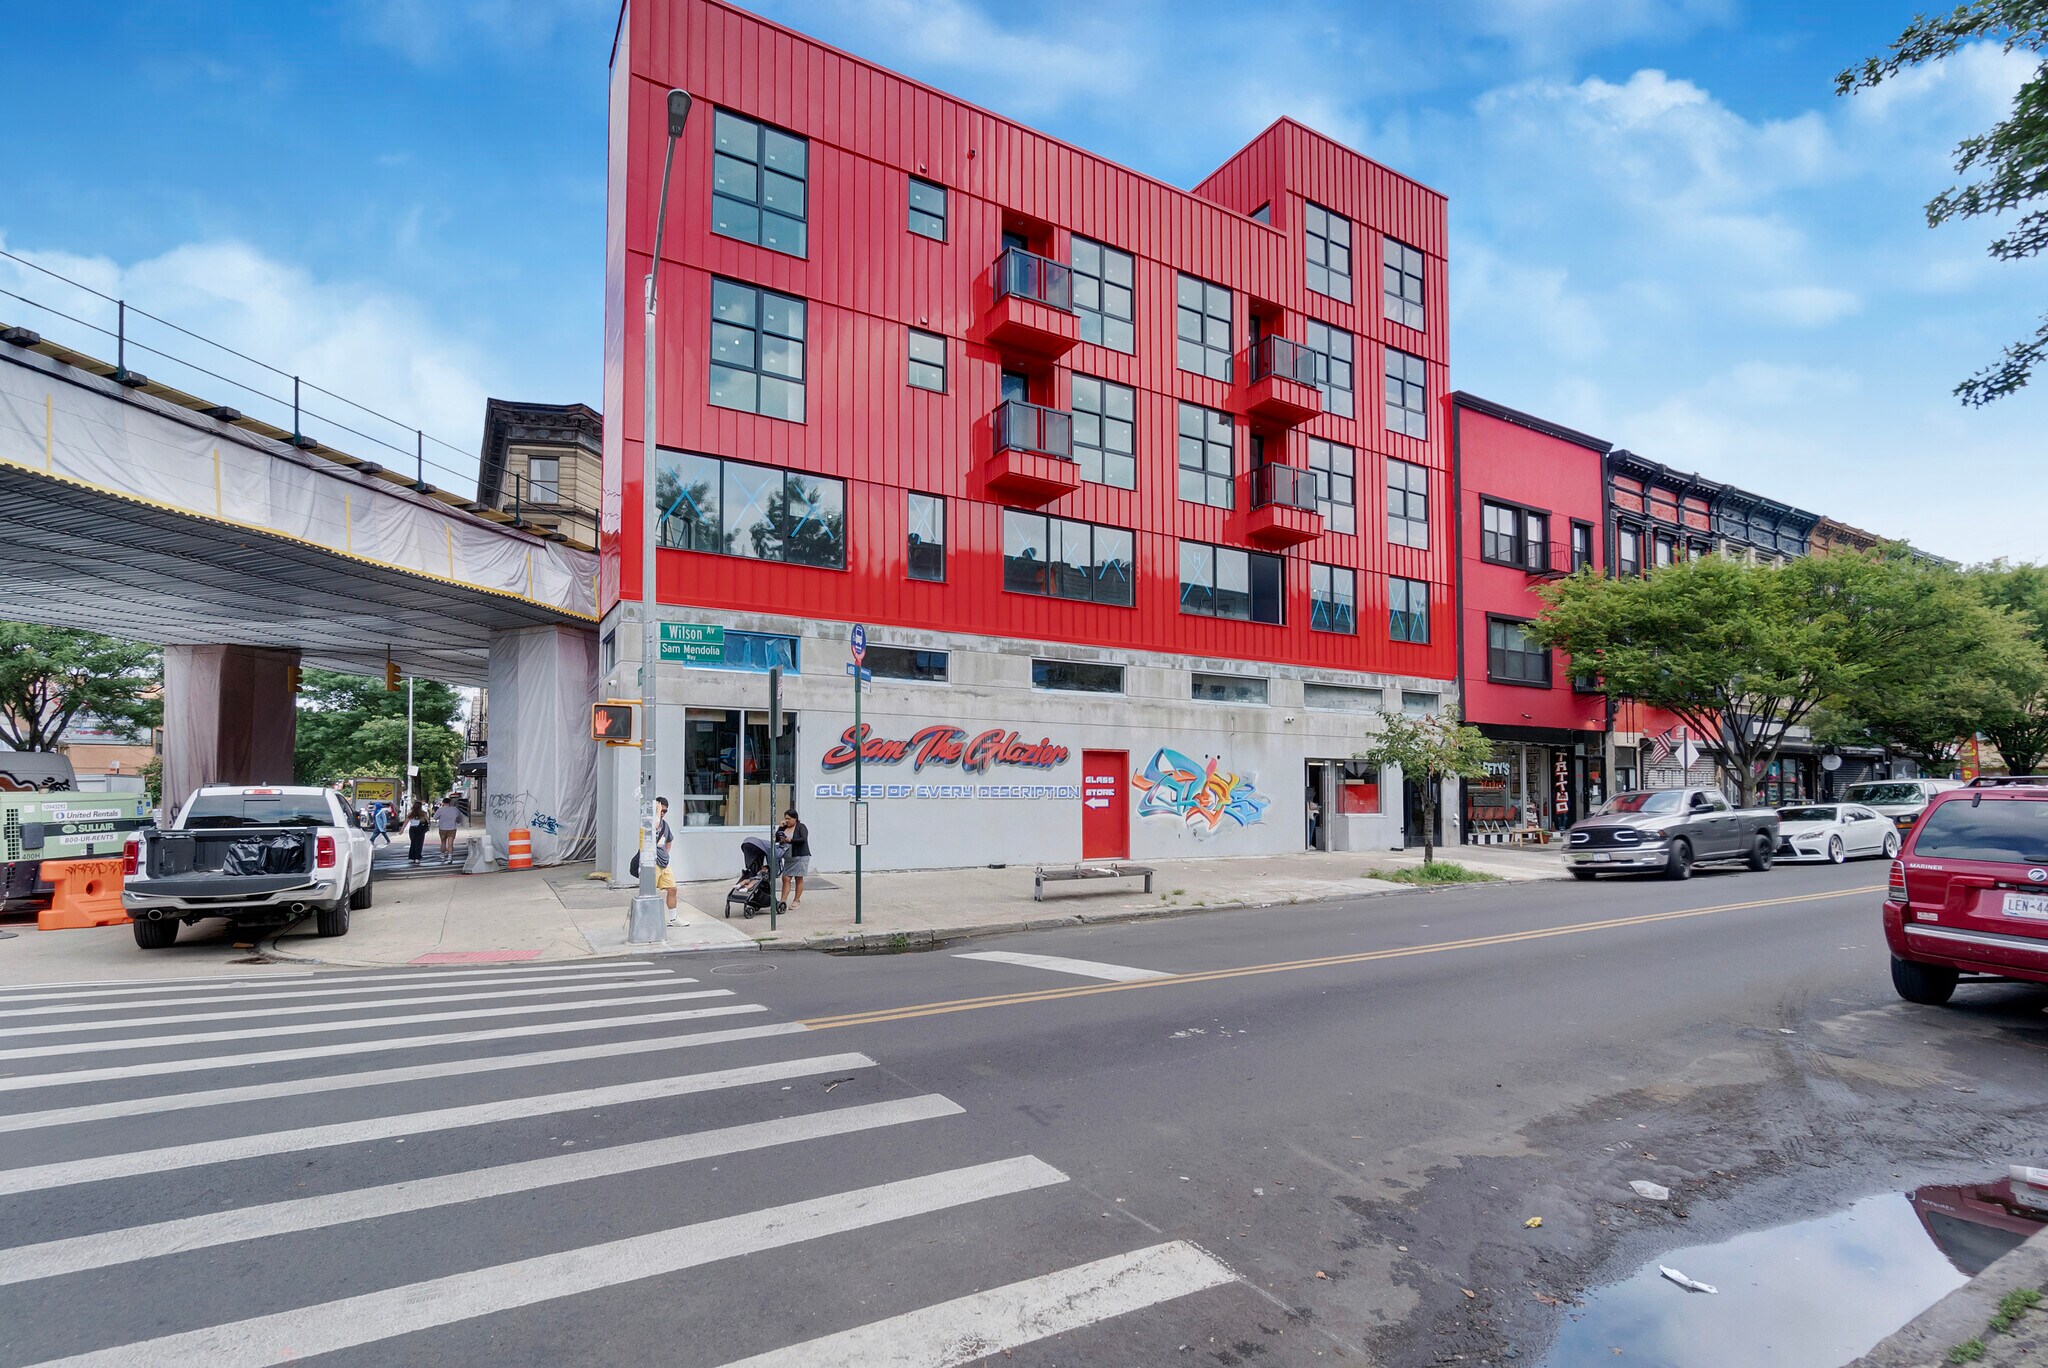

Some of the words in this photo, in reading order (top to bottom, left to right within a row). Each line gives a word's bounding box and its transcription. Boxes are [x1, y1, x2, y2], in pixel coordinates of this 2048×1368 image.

[669, 625, 703, 640] Wilson
[706, 626, 715, 635] Av
[662, 643, 681, 654] Sam
[683, 644, 720, 656] Mendolia
[821, 722, 909, 771] Sam
[907, 725, 967, 772] The
[961, 728, 1070, 775] Glazier
[1085, 776, 1115, 785] GLASS
[815, 784, 884, 798] GLASS
[887, 784, 913, 798] OF
[916, 785, 974, 799] EVERY
[977, 785, 1081, 800] DESCRIPTION
[1085, 788, 1115, 797] STORE
[66, 810, 92, 819] United
[93, 808, 119, 818] Rentals
[78, 823, 115, 833] SULLAIR
[1909, 863, 1943, 871] MARINER
